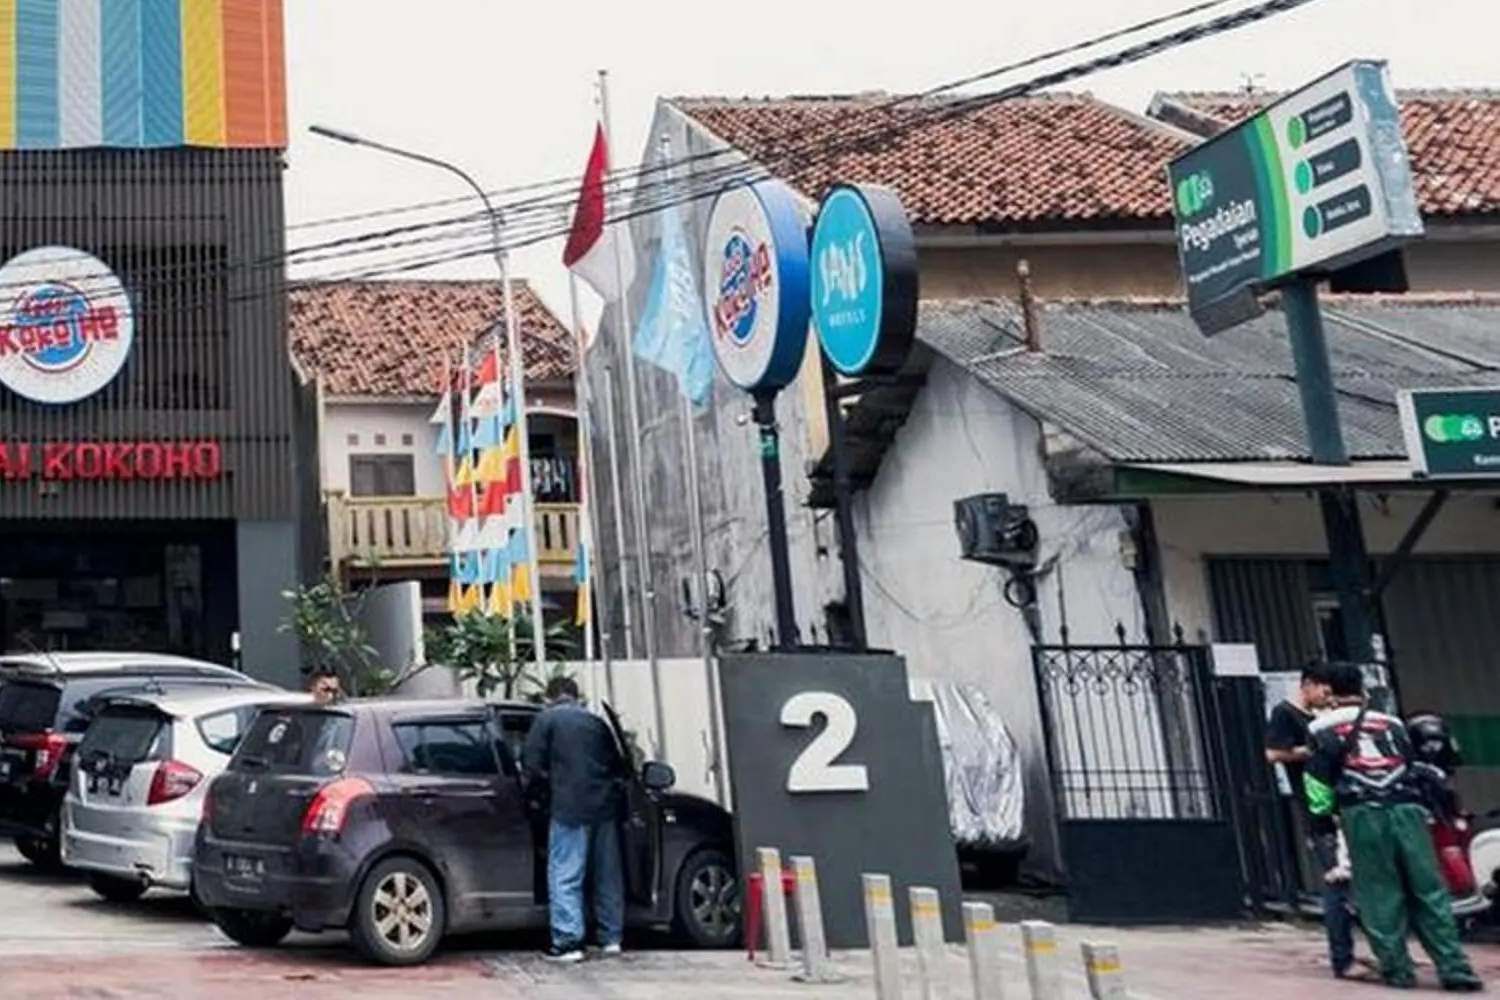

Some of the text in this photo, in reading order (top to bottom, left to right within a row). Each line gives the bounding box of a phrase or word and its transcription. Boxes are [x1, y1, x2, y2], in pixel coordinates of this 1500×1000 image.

[819, 231, 867, 308] SANS
[43, 440, 221, 482] KOKOHO
[780, 690, 869, 792] 2
